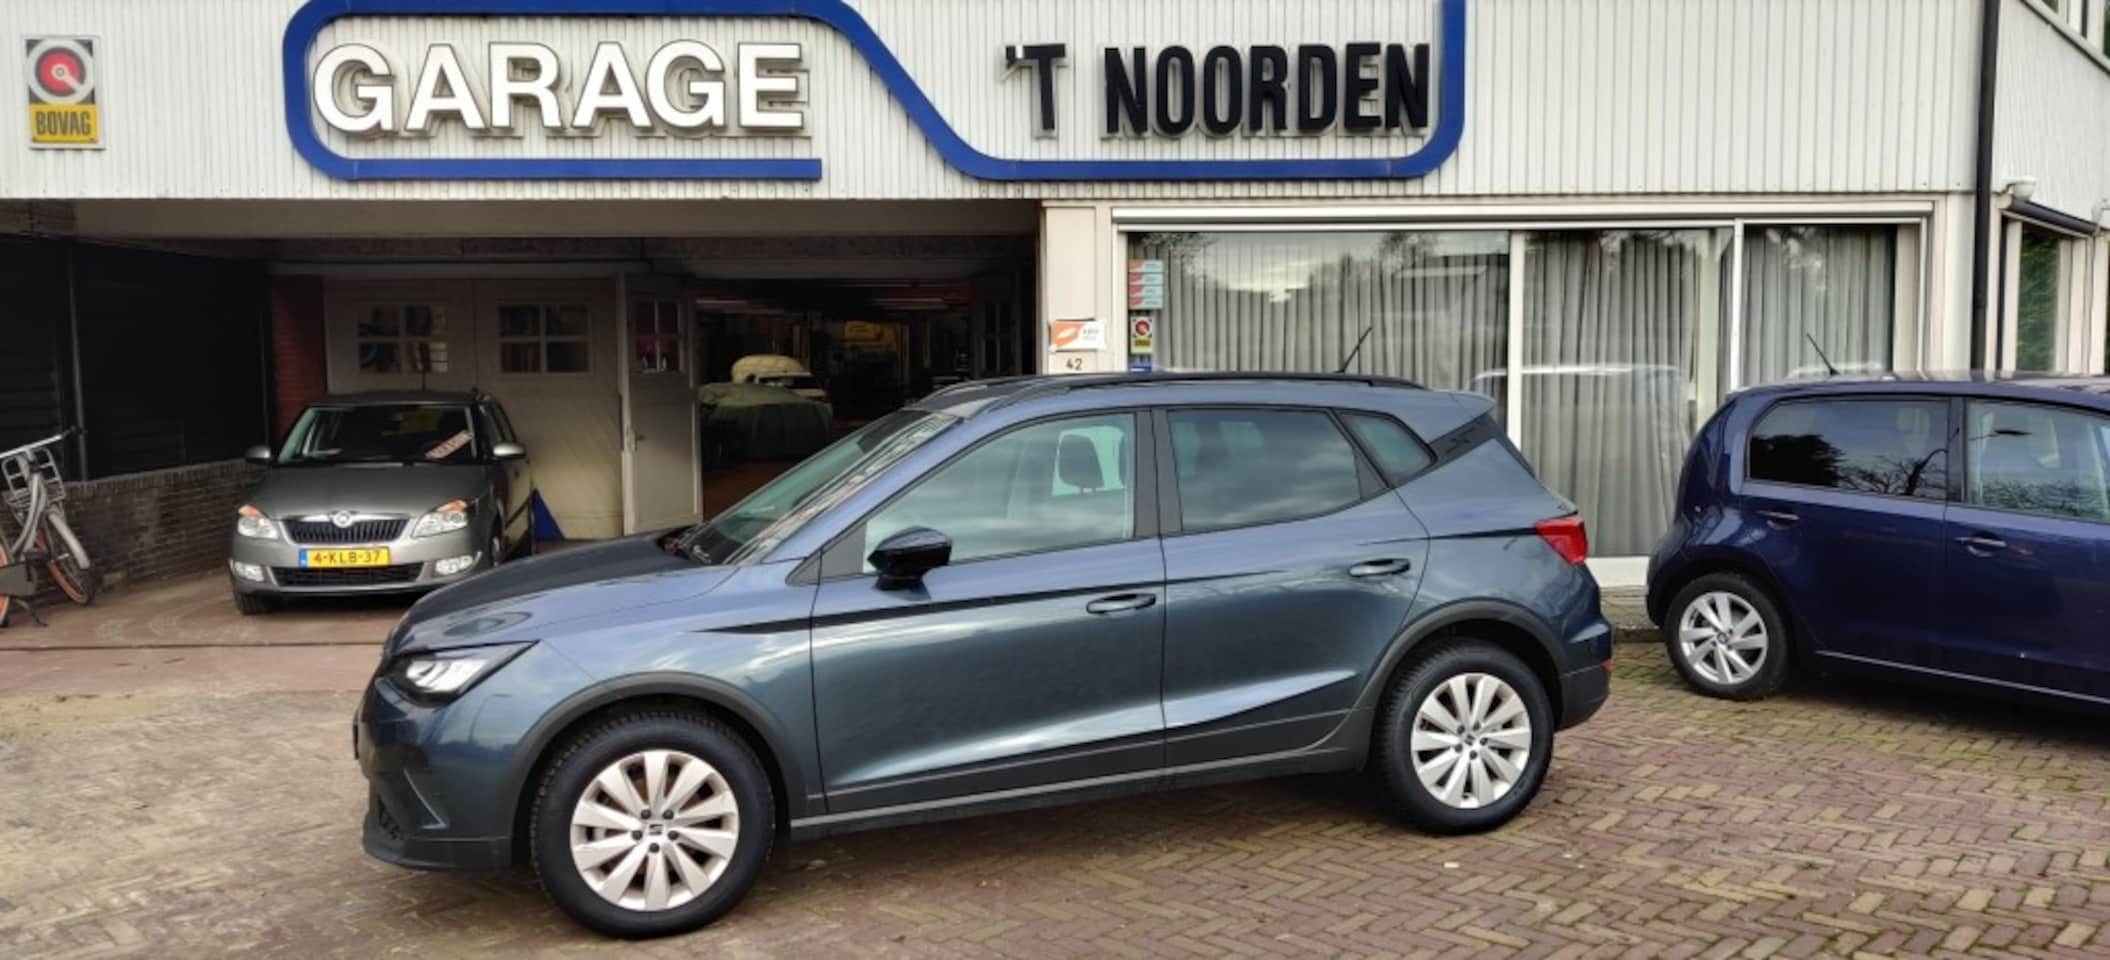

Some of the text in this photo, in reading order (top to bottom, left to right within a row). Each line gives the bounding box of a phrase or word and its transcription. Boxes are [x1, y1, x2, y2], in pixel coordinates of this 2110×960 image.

[313, 39, 1430, 134] GARAGE 'T NOORDEN
[35, 110, 91, 136] BOVAG
[1065, 358, 1082, 370] 42
[313, 550, 381, 564] 4-KLB-37
